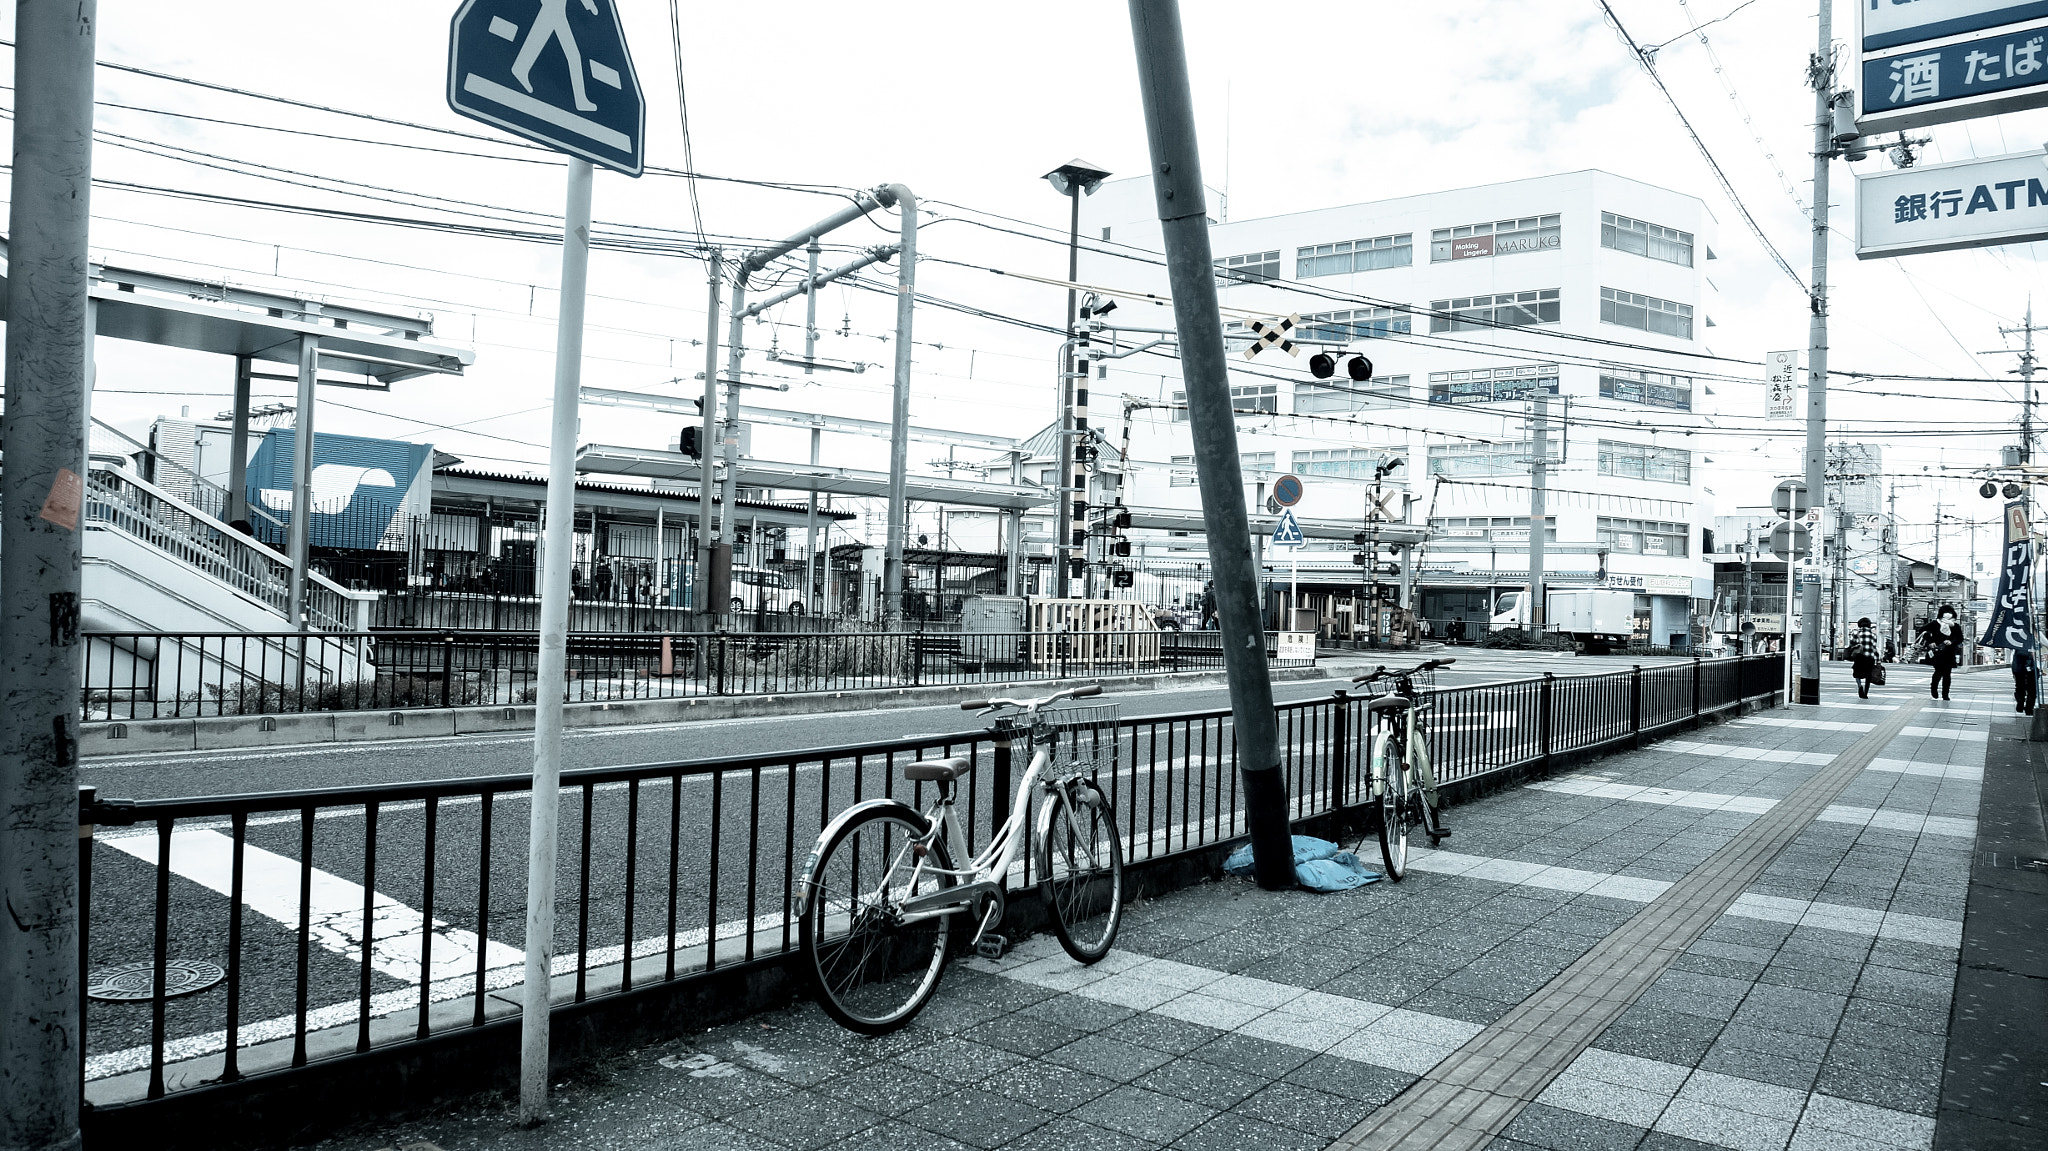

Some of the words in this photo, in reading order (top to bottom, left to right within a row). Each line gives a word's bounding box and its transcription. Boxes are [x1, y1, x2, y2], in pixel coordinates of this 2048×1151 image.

[1889, 53, 1941, 103] 酒
[1964, 35, 2048, 85] たば
[1894, 177, 2048, 224] 銀行ATM
[1456, 242, 1479, 251] Making
[1463, 249, 1489, 257] Lingerie
[1496, 235, 1560, 253] MARUKO
[1783, 364, 1793, 393] 近江牛
[1607, 576, 1643, 587] 方せん受付
